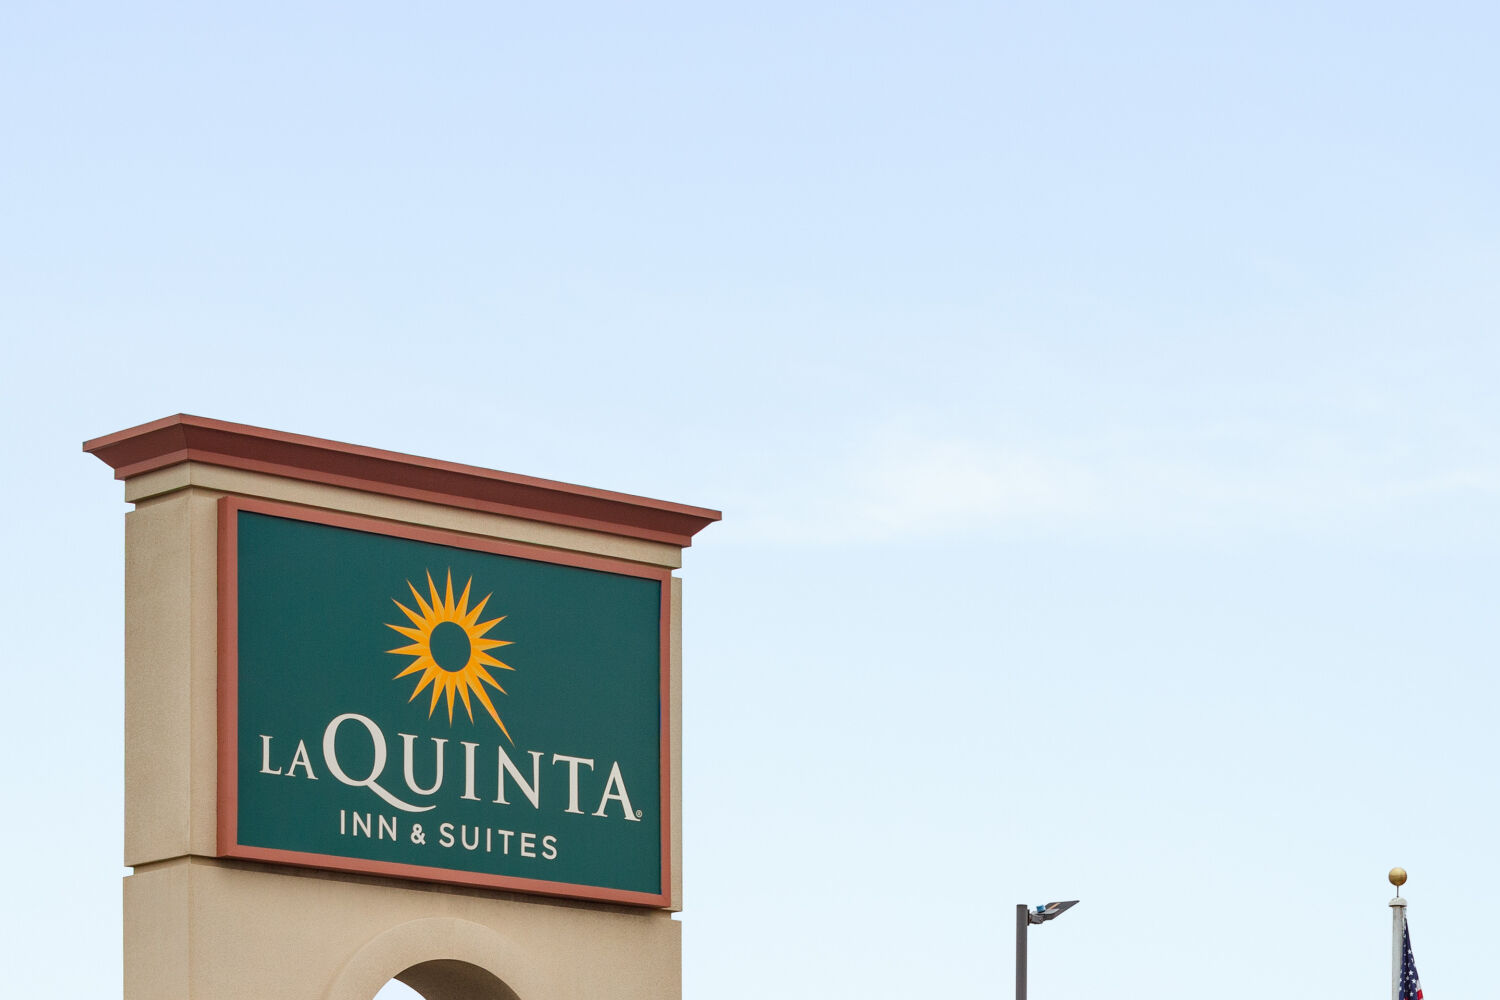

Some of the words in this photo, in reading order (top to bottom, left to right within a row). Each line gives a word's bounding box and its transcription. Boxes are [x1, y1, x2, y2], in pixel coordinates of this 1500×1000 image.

[340, 809, 397, 842] INN
[410, 823, 426, 846] &
[438, 822, 558, 860] SUITES
